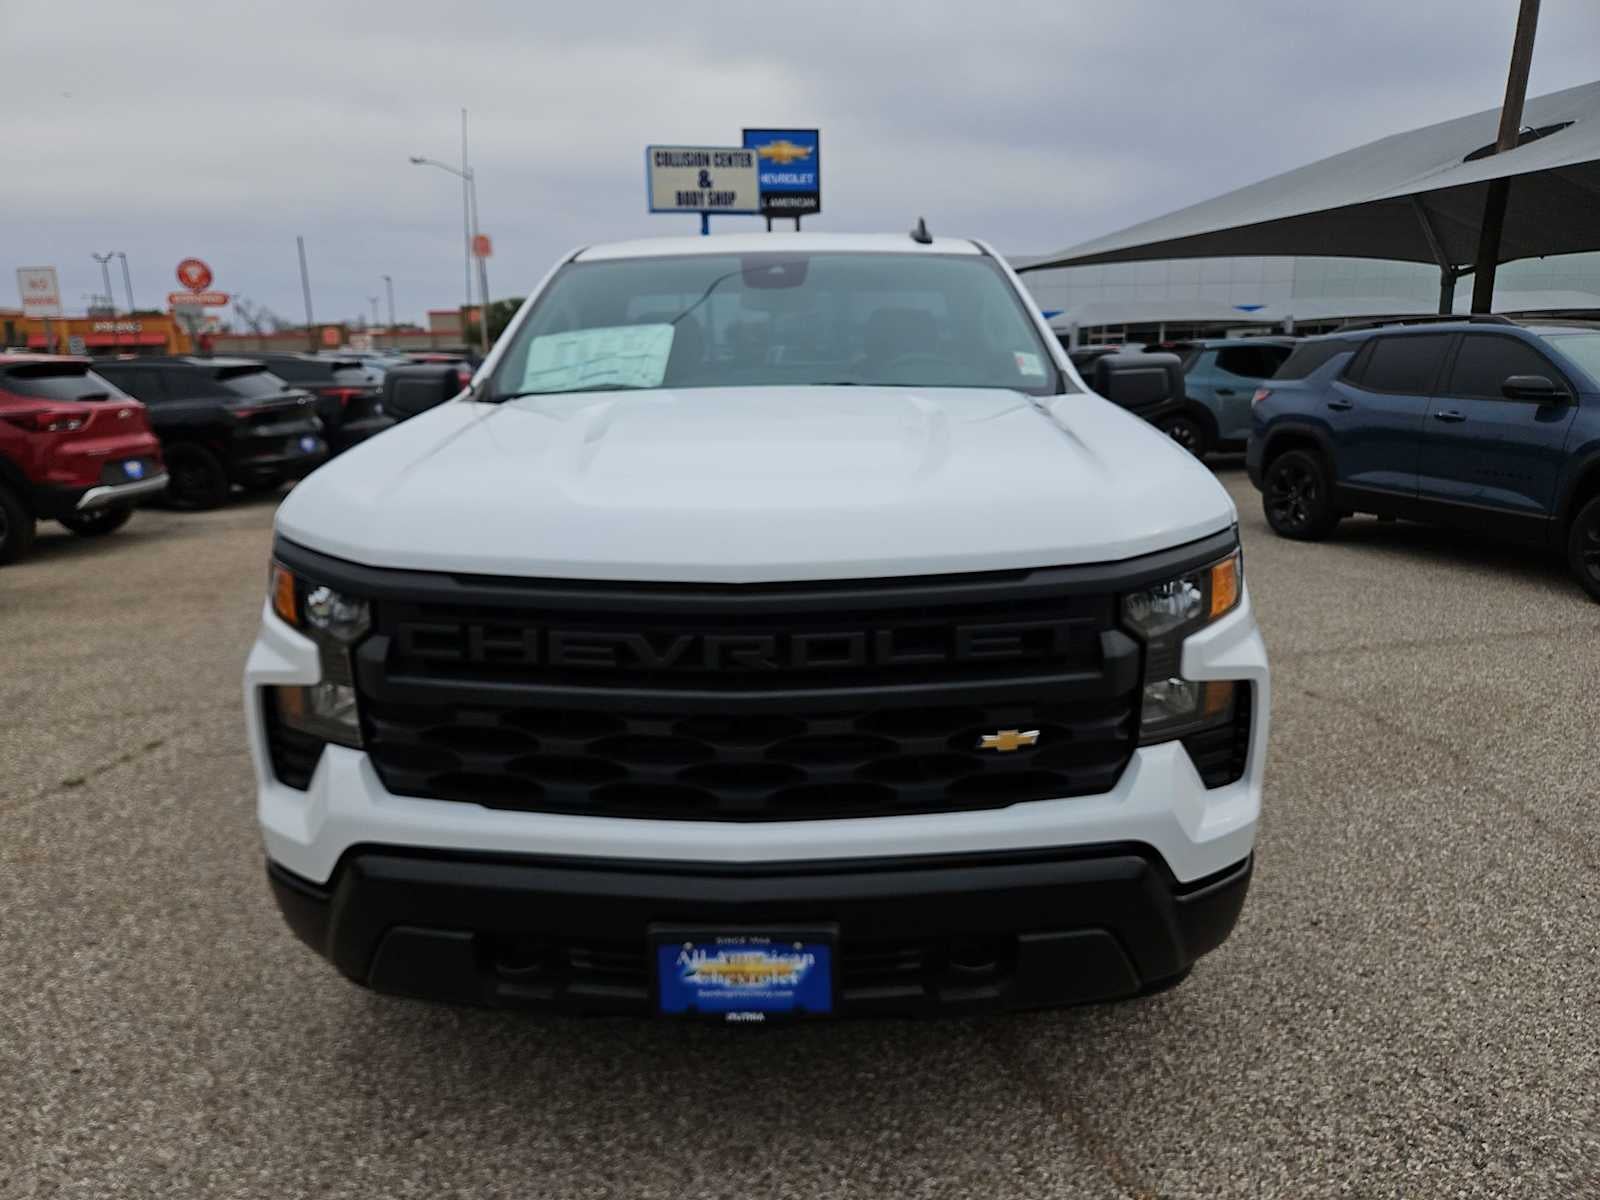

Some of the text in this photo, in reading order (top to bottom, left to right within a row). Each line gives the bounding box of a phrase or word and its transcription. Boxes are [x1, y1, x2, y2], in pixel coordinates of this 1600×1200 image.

[654, 151, 753, 168] COLLISION CENTER
[697, 169, 712, 189] &
[675, 190, 736, 207] BODY SHOP
[770, 197, 816, 208] AMERICAN
[400, 618, 1095, 670] CHEVROLET
